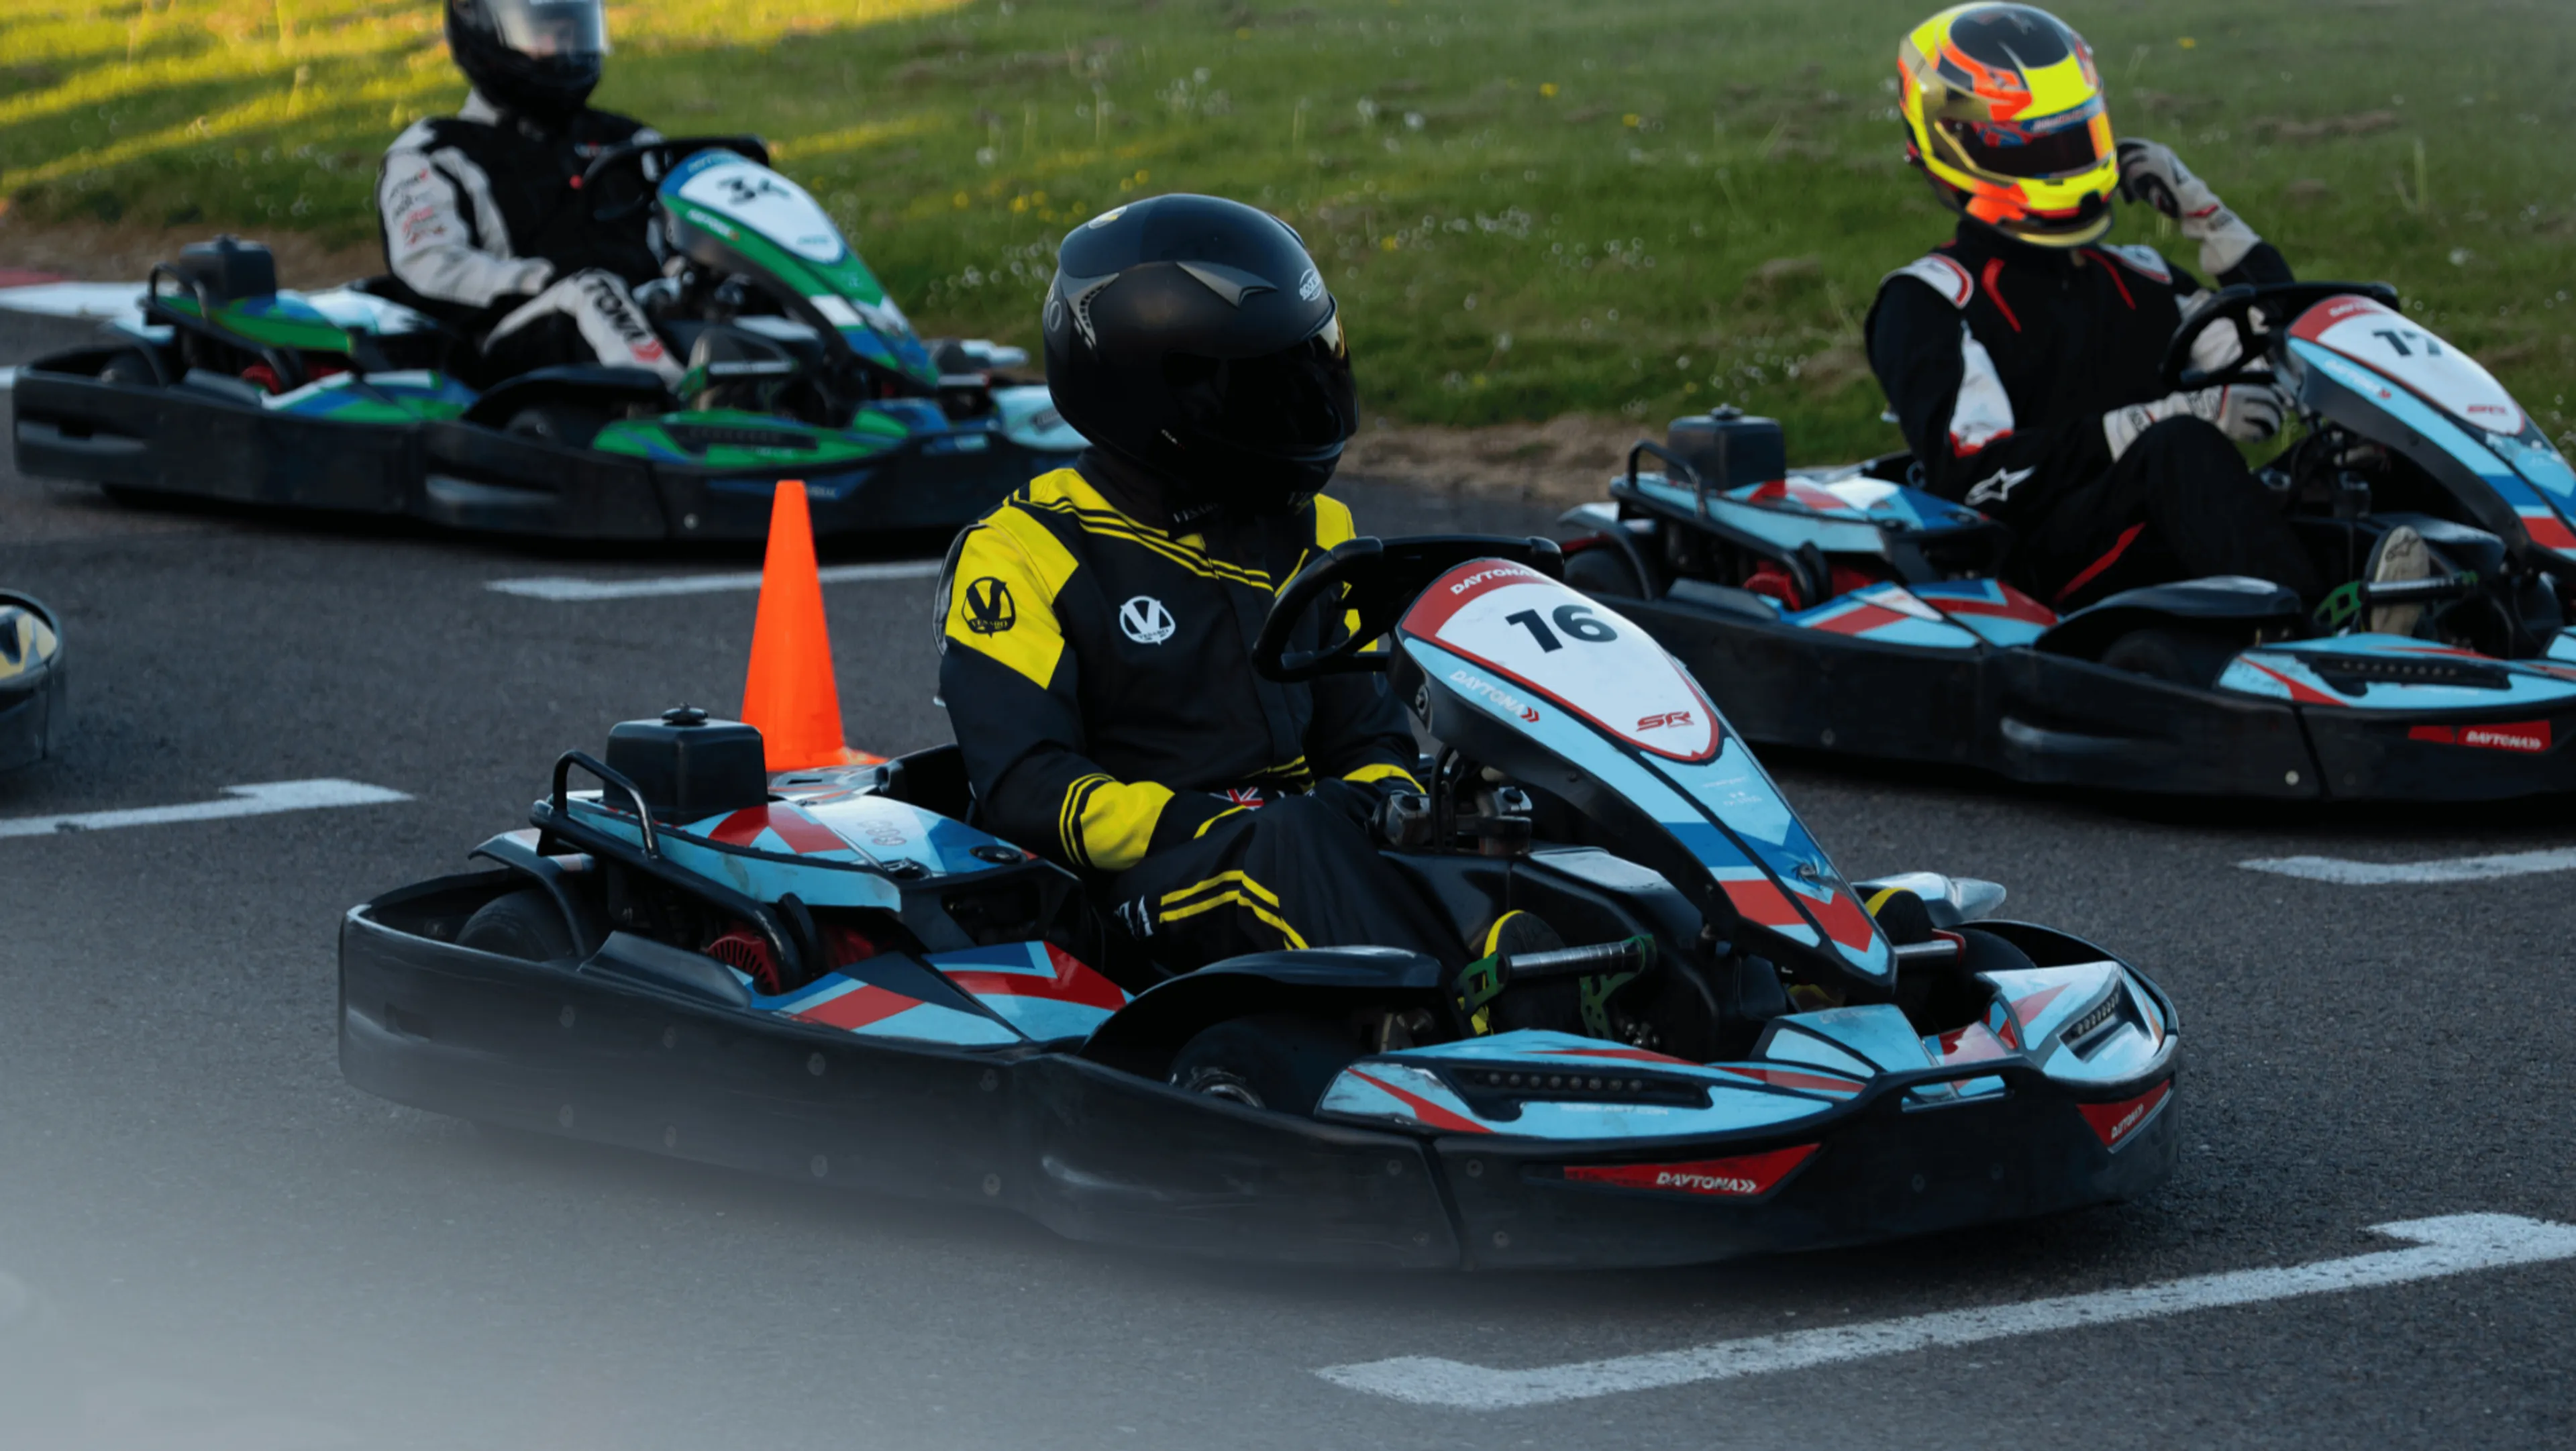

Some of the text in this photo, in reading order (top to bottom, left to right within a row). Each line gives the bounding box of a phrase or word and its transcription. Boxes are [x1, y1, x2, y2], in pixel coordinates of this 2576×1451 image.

[2371, 329, 2442, 357] 17
[1505, 604, 1618, 653] 16
[1449, 669, 1526, 716] DAYTONA
[1635, 711, 1694, 732] SR
[1656, 1172, 1739, 1191] DAYTONA
